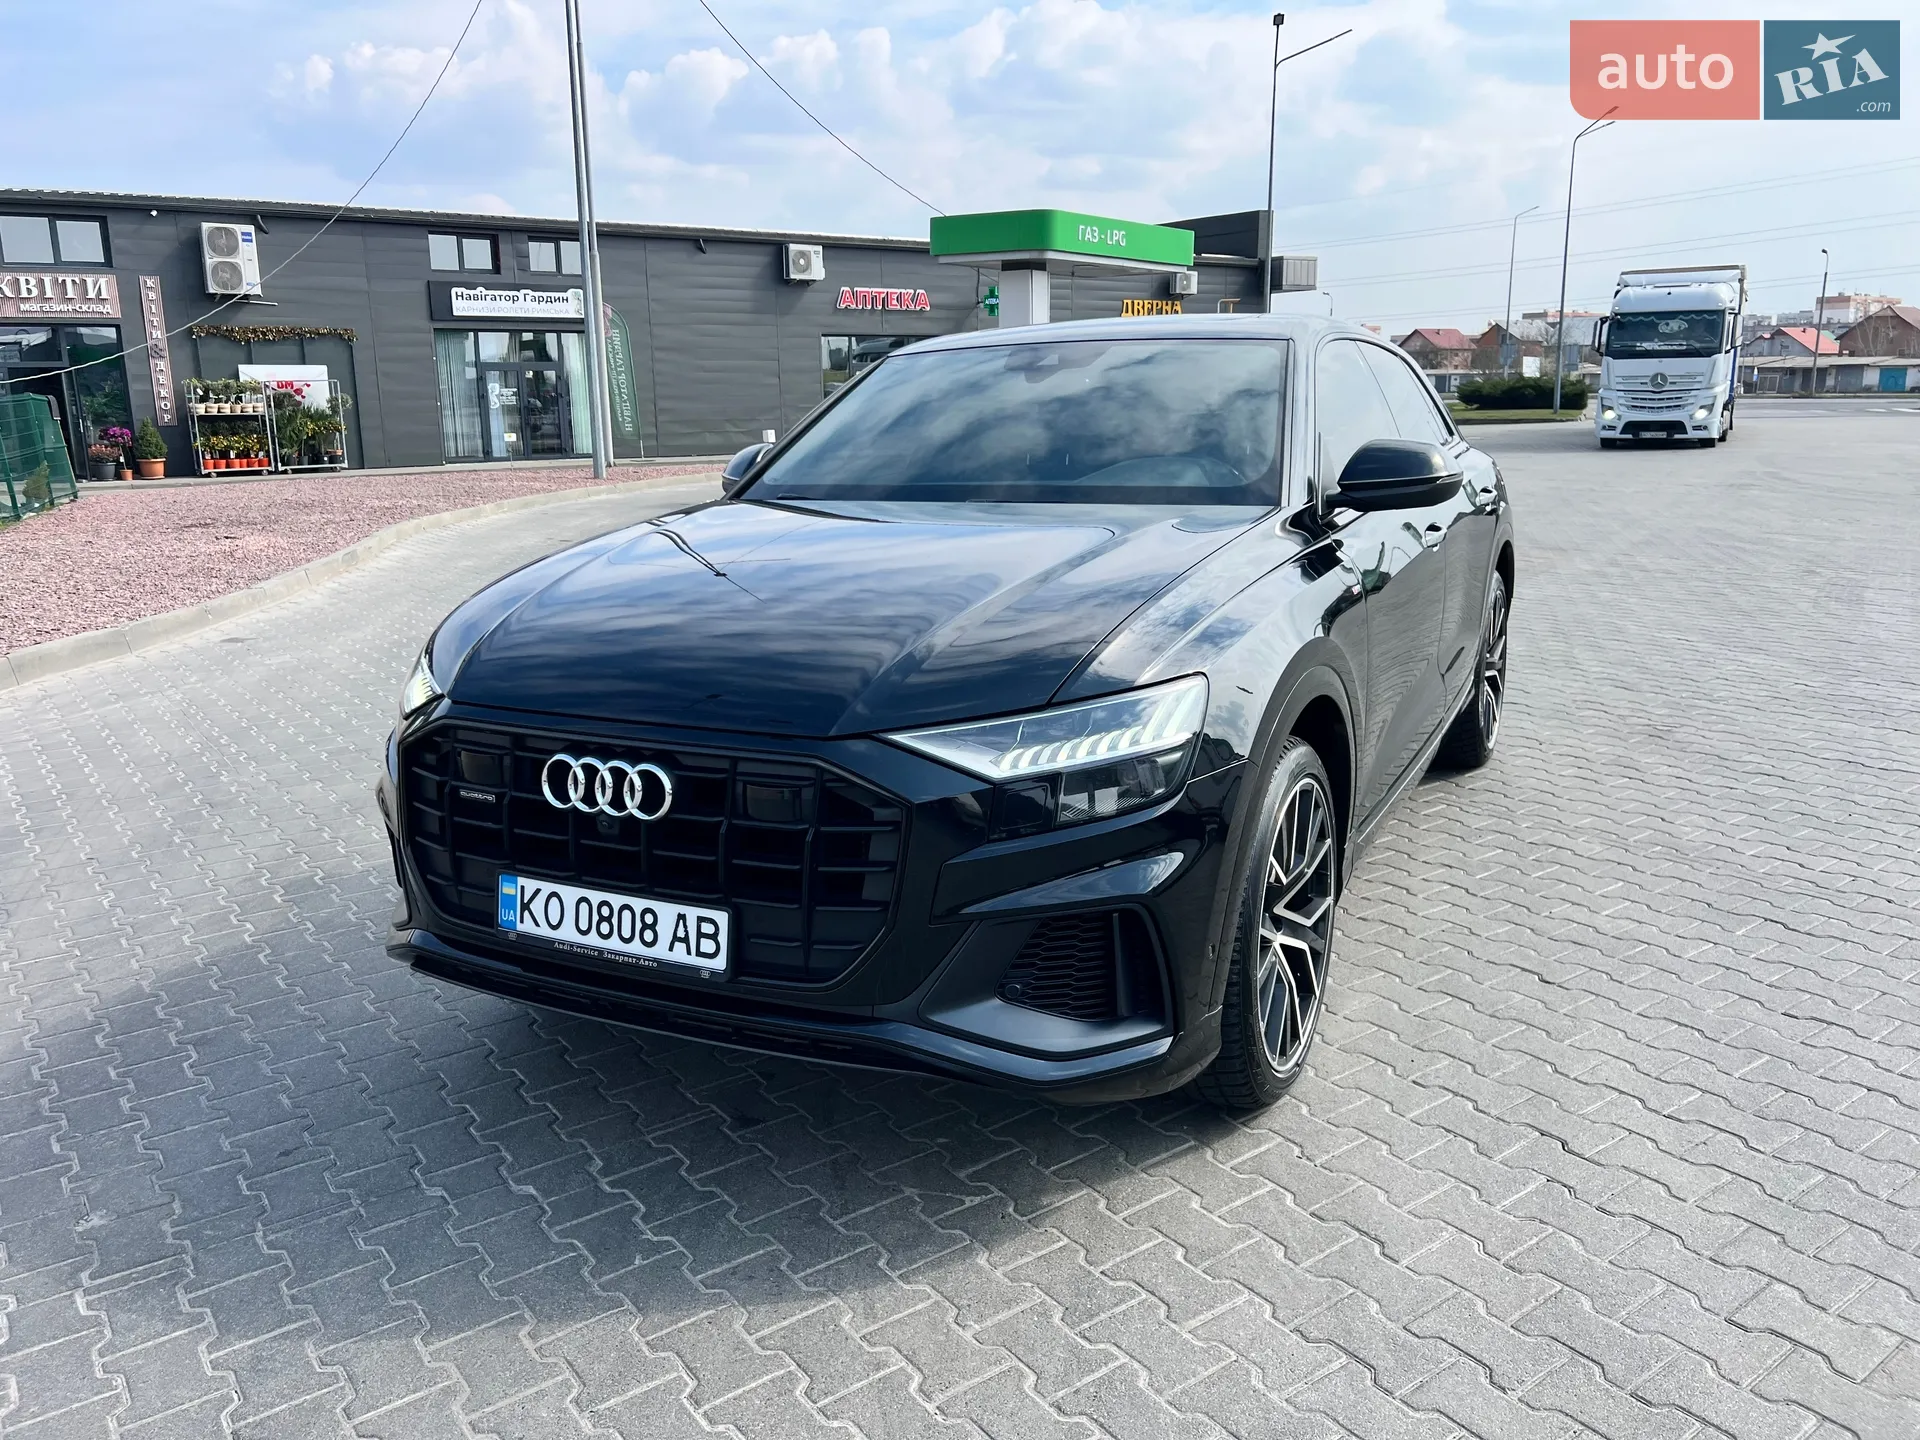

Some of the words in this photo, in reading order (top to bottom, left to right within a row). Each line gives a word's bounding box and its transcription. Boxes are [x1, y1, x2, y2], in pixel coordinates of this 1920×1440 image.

[1078, 224, 1099, 243] ГАЗ
[1106, 229, 1126, 246] LPG
[0, 275, 111, 299] КВІТИ
[455, 290, 520, 304] Навігатор
[523, 292, 569, 304] Гардин
[20, 303, 112, 315] магазин-склад
[144, 278, 161, 339] КВІТИ
[837, 287, 931, 311] АПТЕКА
[1121, 299, 1182, 318] ДВЕРНА
[501, 907, 516, 922] UA
[519, 885, 565, 931] KO
[574, 896, 659, 948] 0808
[668, 912, 721, 960] AB
[553, 941, 599, 956] Audi-Service
